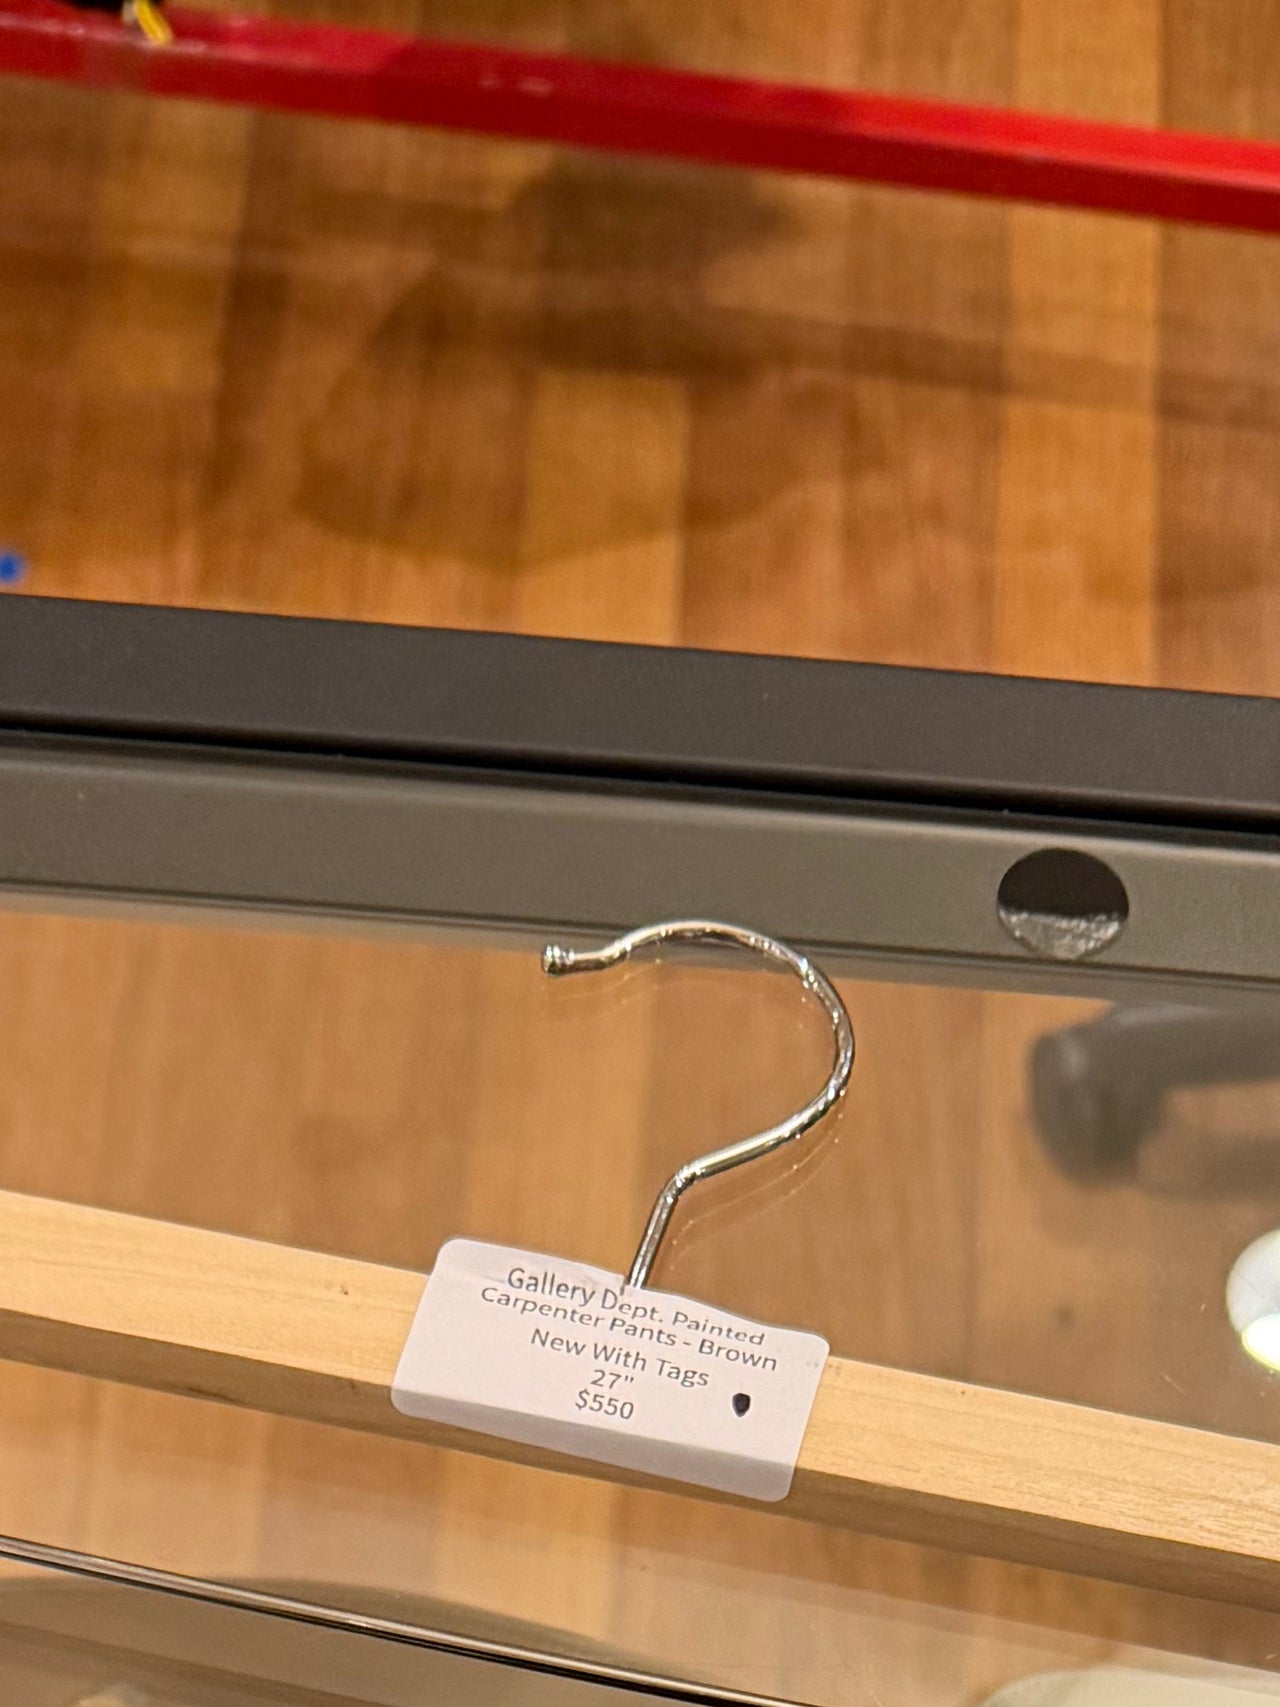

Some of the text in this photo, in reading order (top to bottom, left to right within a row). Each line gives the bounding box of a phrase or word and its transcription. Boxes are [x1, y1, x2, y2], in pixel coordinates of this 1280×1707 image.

[481, 1287, 606, 1328] Carpenter
[609, 1318, 677, 1347] Pants
[698, 1338, 777, 1371] Brown
[507, 1267, 766, 1346] Gallery Dept. Painted
[531, 1328, 710, 1388] New With Tags
[590, 1369, 635, 1390] 27"
[575, 1388, 635, 1420] $550
